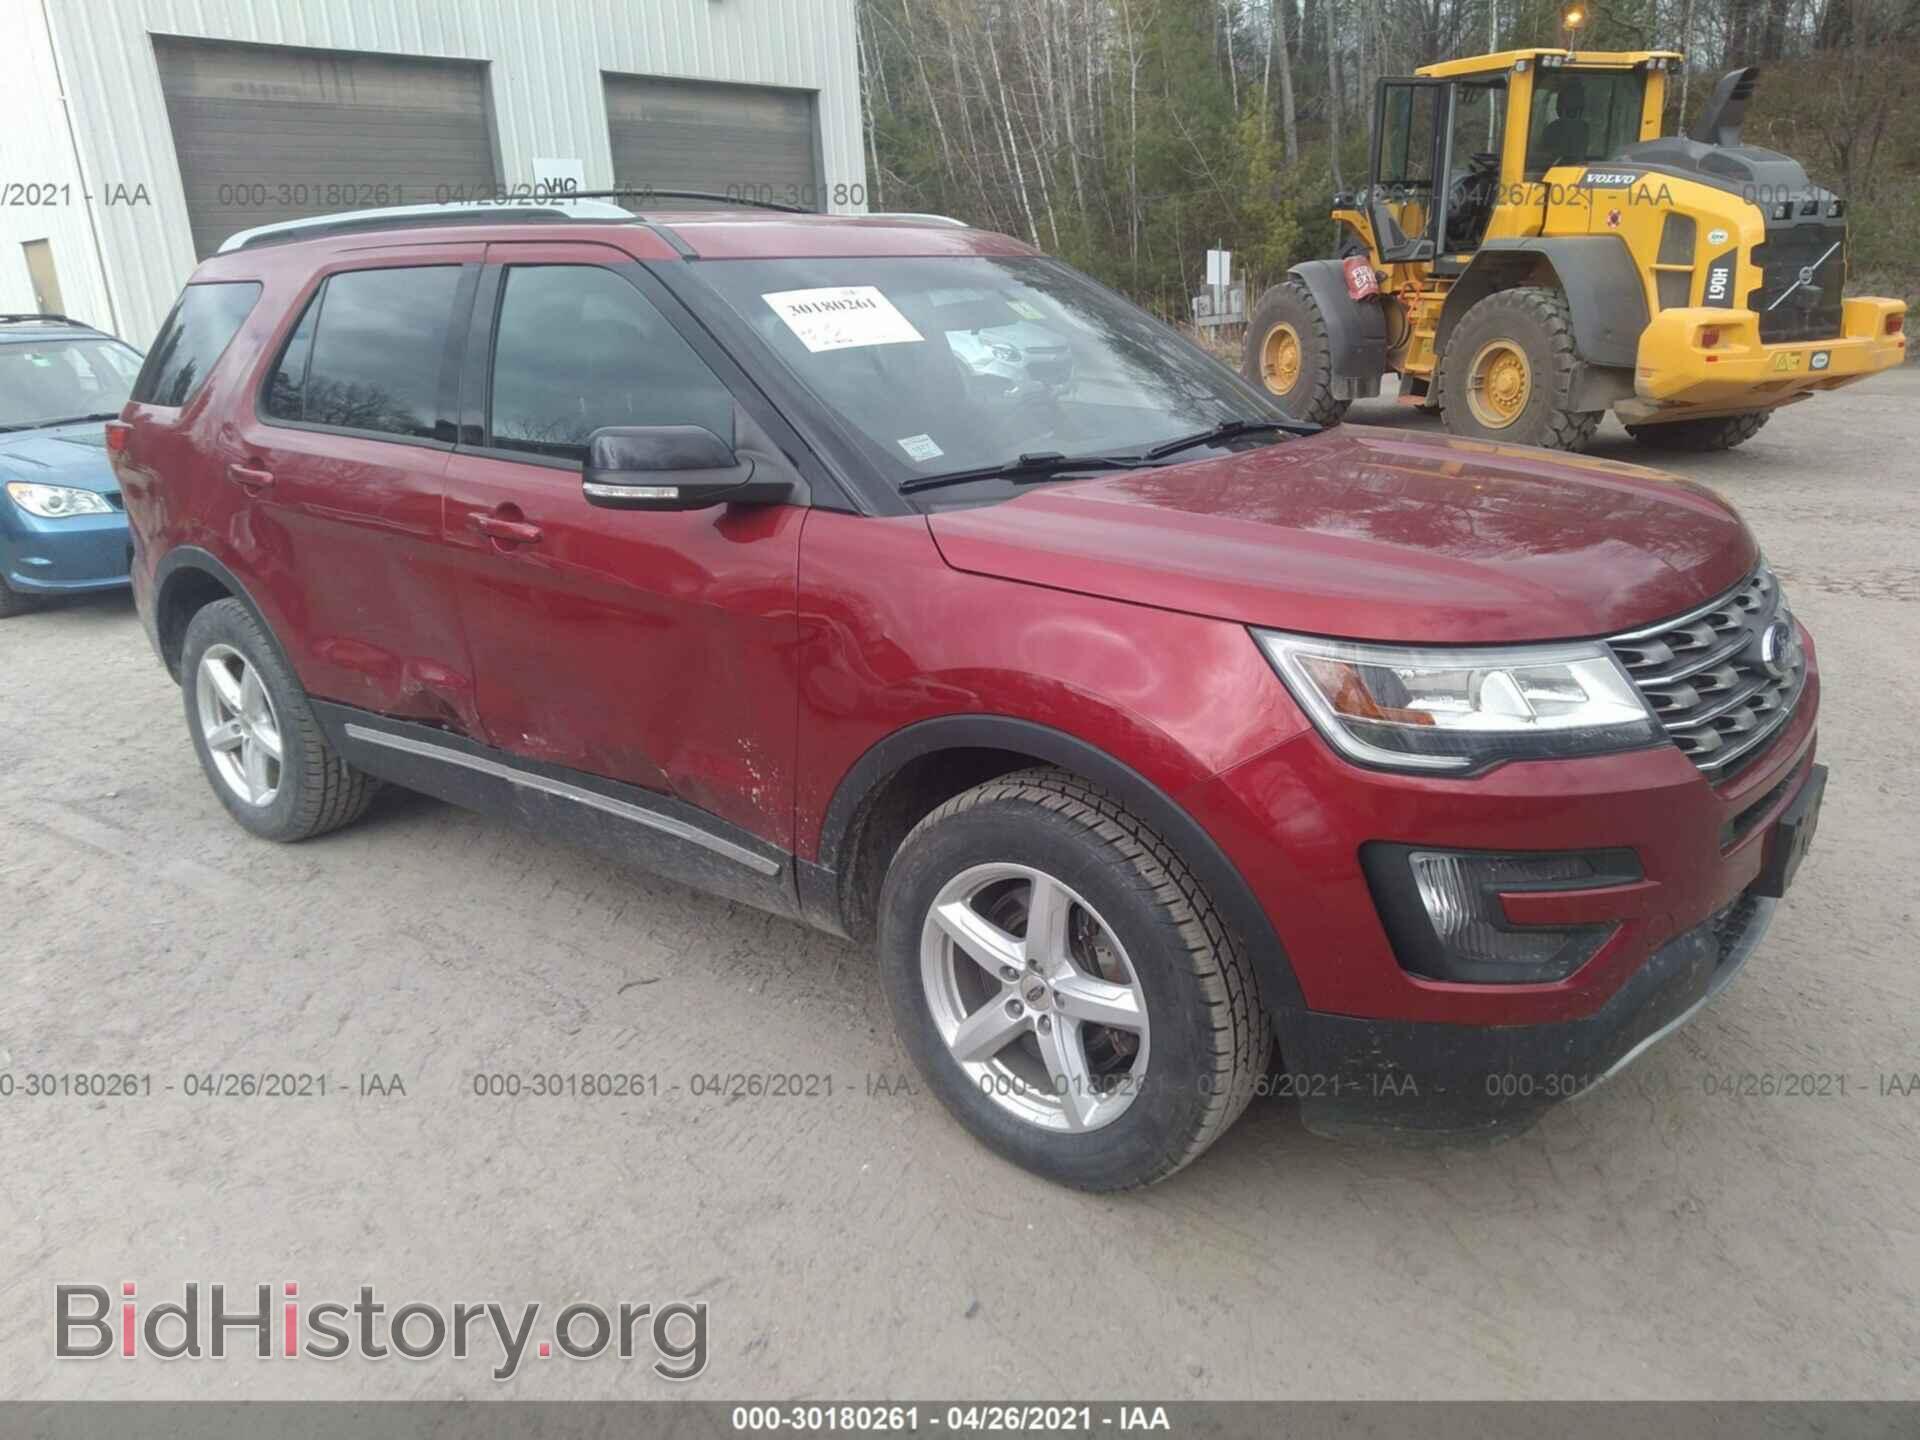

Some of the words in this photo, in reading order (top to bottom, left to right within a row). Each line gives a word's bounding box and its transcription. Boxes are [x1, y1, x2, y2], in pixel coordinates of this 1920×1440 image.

[1586, 173, 1636, 185] VOLVO
[1708, 268, 1729, 301] L90H
[787, 297, 878, 317] 30180261
